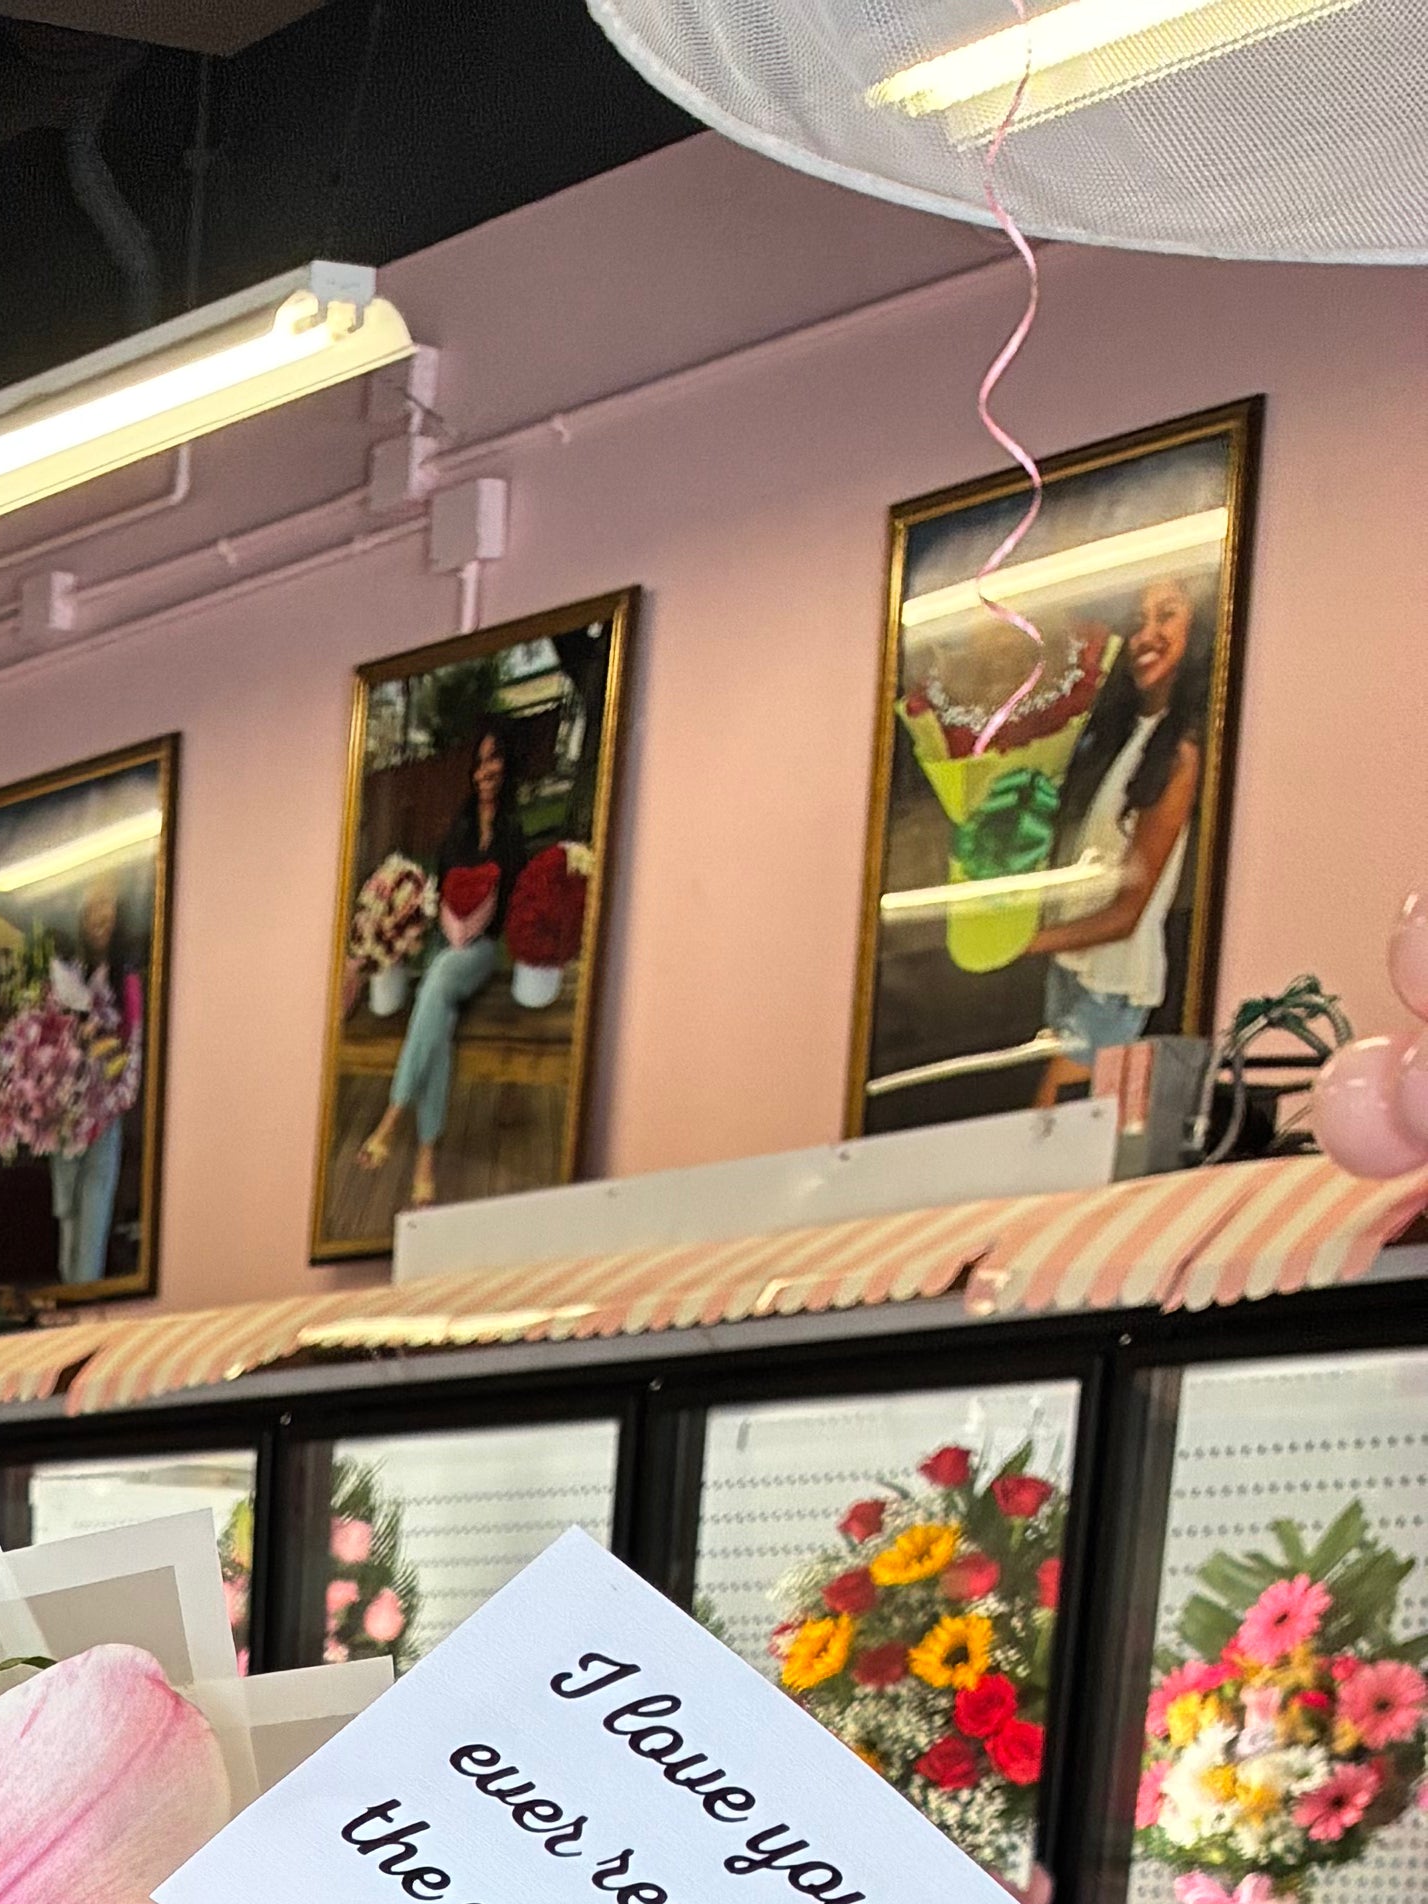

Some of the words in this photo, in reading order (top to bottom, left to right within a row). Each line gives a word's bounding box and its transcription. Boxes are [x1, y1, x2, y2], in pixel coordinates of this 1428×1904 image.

[549, 1652, 641, 1700] I
[602, 1694, 756, 1823] love
[341, 1798, 451, 1901] the
[449, 1743, 589, 1858] ever
